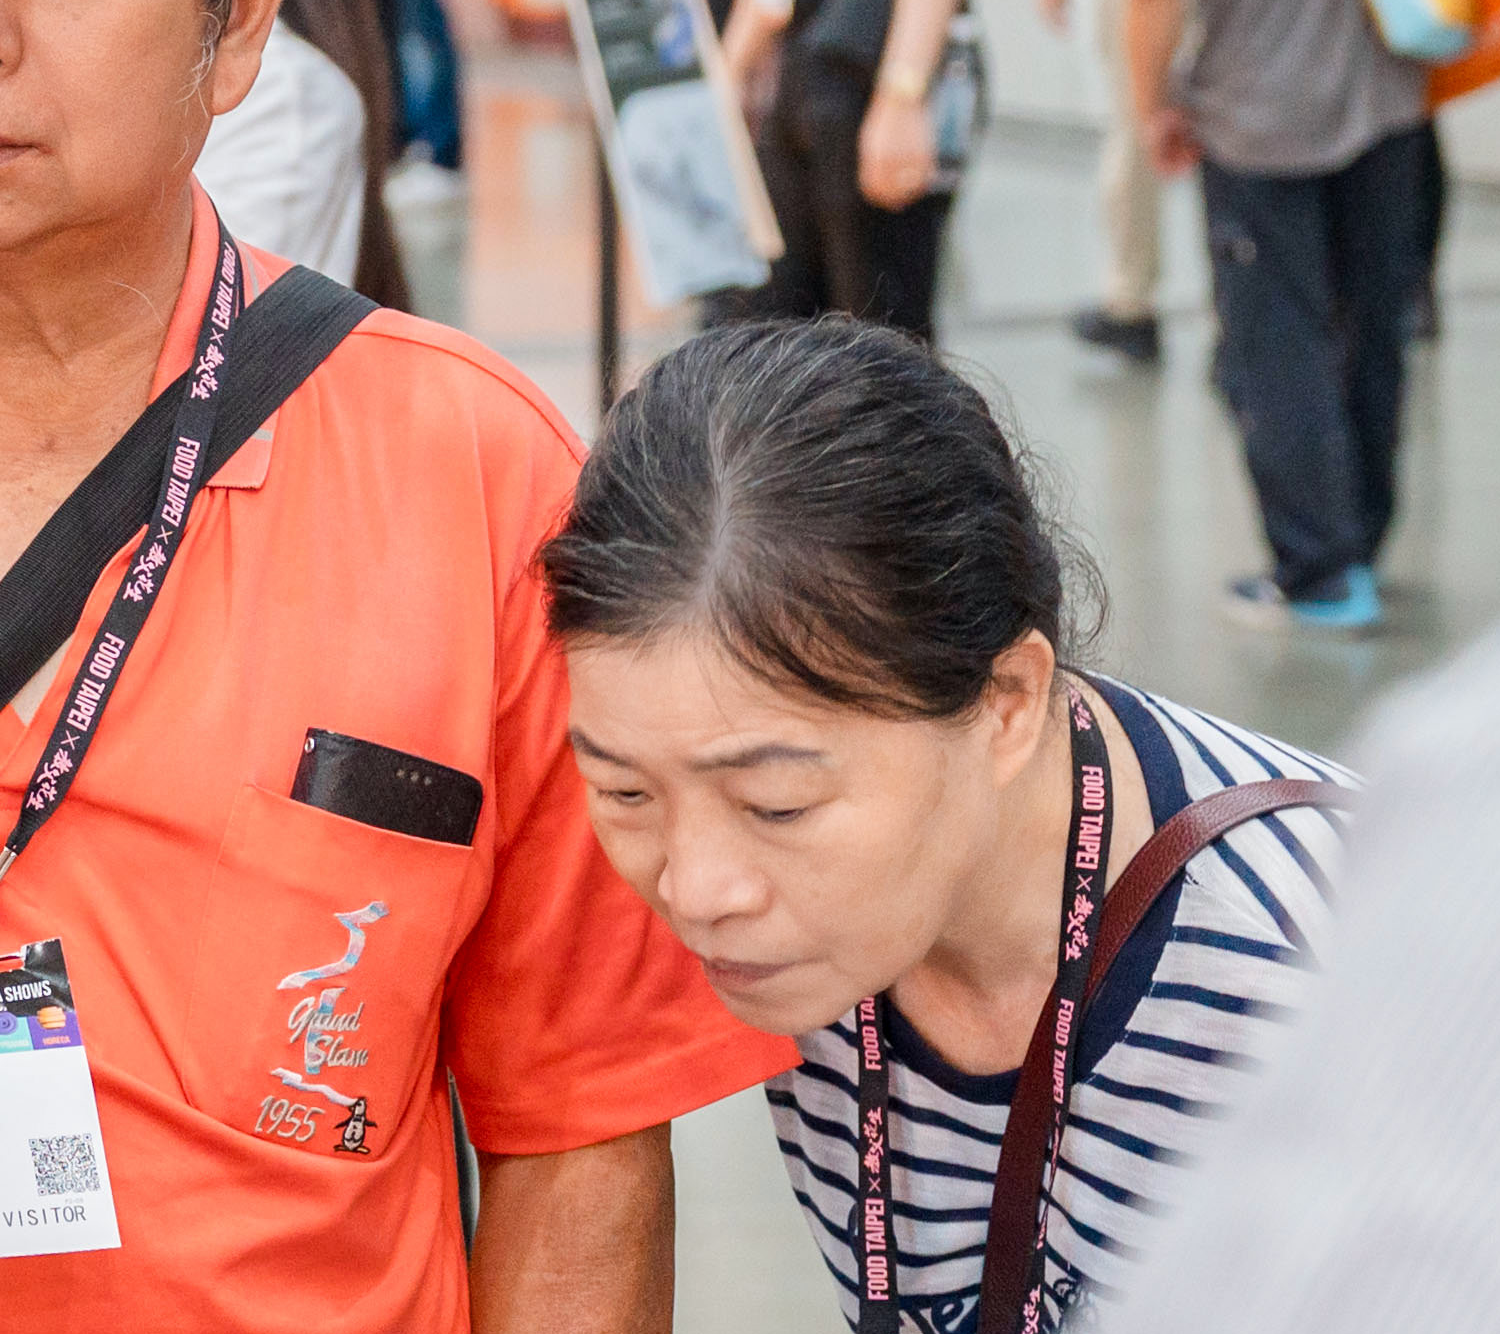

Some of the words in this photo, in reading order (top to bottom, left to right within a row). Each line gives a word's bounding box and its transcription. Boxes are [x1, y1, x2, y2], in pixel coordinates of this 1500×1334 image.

[221, 242, 236, 285] FOOD
[211, 281, 234, 330] TAIPEI
[172, 436, 200, 480] FOOD
[161, 477, 190, 528] TAIPEI
[88, 631, 126, 680] FOOD
[66, 677, 106, 732] TAIPEI
[1082, 765, 1105, 811] FOOD
[1075, 814, 1104, 870] TAIPEI
[4, 980, 52, 1004] SHOWS
[1055, 998, 1075, 1047] FOOD
[309, 1034, 369, 1068] Slam
[861, 1025, 882, 1071] FOOD
[1053, 1050, 1067, 1105] TAIPEI
[254, 1095, 326, 1143] 1955
[3, 1205, 87, 1228] VISITOR
[865, 1197, 887, 1254] TAIPEI
[867, 1255, 889, 1302] FOOD
